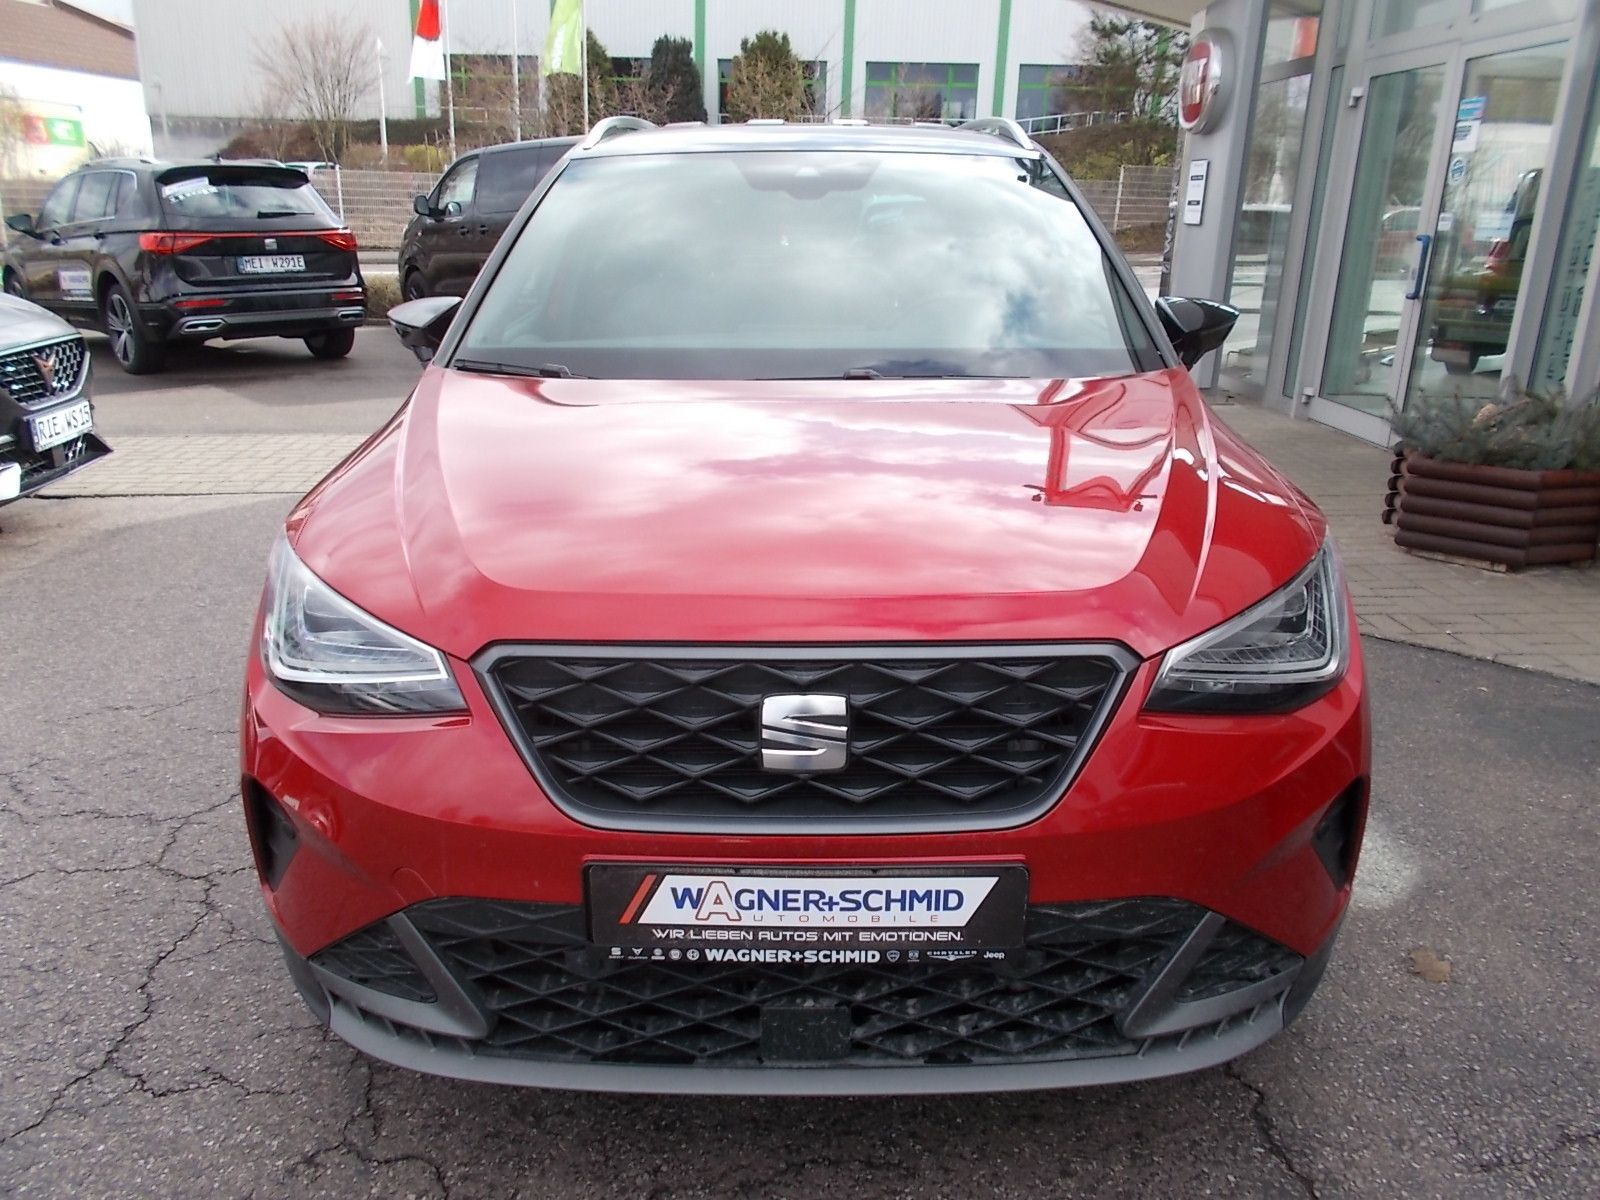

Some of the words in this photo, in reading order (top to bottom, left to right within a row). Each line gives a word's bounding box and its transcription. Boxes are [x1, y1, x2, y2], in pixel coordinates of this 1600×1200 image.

[38, 416, 61, 440] RIE
[652, 928, 685, 940] WIR
[689, 929, 753, 941] LIEBEN
[758, 930, 818, 942] AUTOS
[823, 931, 854, 942] MIT
[859, 931, 964, 942] EMOTIONEN.
[704, 948, 881, 963] WAGNER+SCHMID
[983, 950, 1005, 960] Jeep
